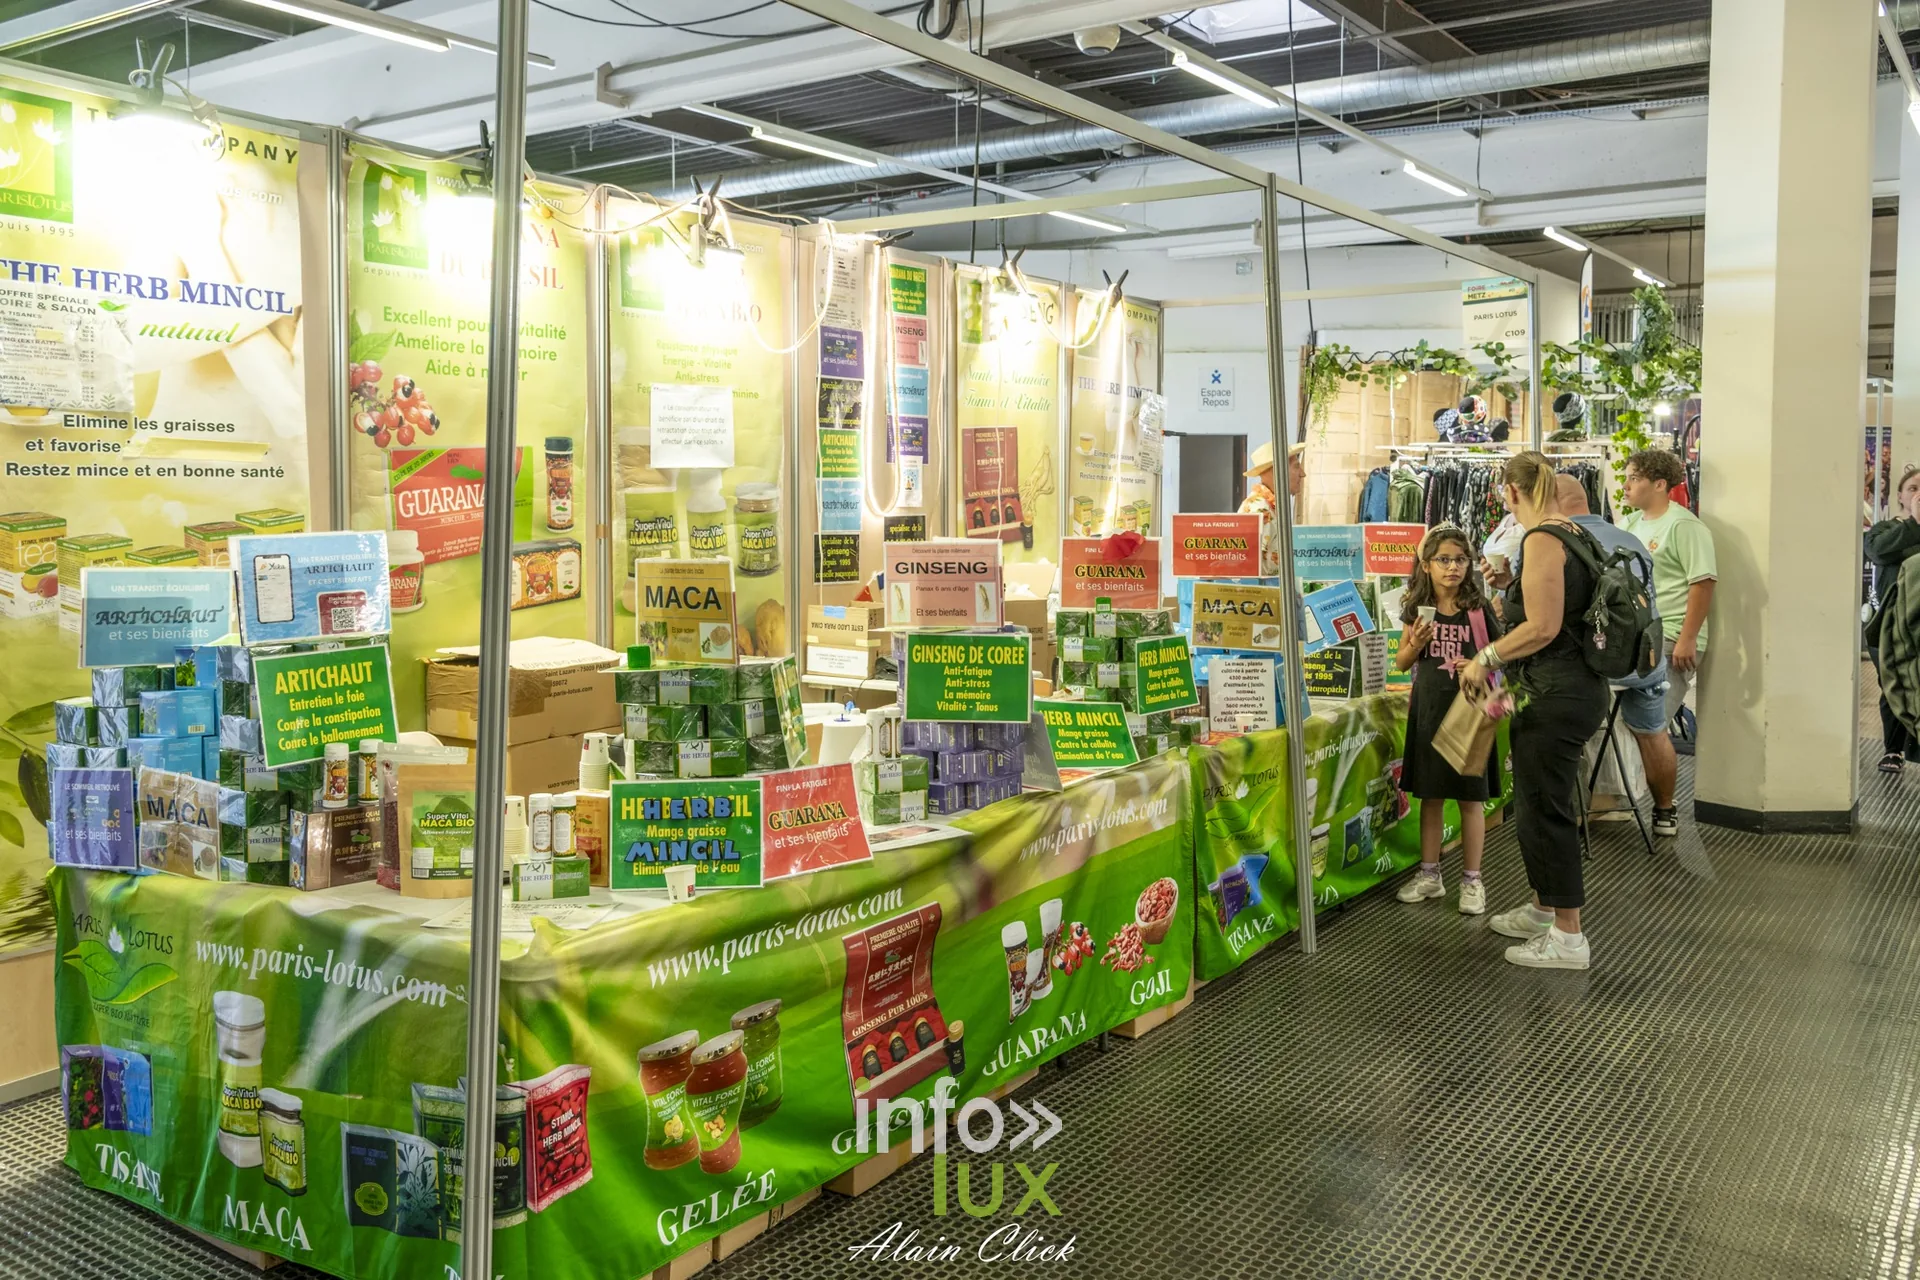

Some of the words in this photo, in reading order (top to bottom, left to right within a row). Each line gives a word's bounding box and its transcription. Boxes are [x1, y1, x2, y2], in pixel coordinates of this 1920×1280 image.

[72, 267, 169, 300] HERB
[179, 279, 294, 315] MINCIL
[383, 306, 452, 329] Excellent
[1505, 329, 1526, 337] C109
[395, 332, 465, 354] Améliore
[471, 339, 485, 355] la
[425, 359, 461, 377] Aide
[466, 361, 475, 377] à
[675, 370, 719, 383] Anti-stress
[1200, 388, 1231, 399] Espace
[1203, 397, 1229, 406] Repos
[63, 414, 128, 430] Elimine
[134, 416, 158, 431] les
[164, 419, 236, 433] graisses
[25, 438, 44, 452] et
[50, 438, 122, 453] favorise
[823, 434, 857, 446] ARTICHAUT
[6, 462, 70, 477] Restez
[76, 462, 129, 477] mince
[134, 464, 151, 477] et
[156, 465, 177, 478] en
[183, 464, 236, 478] bonne
[240, 465, 285, 478] santé
[634, 518, 655, 532] Super
[655, 516, 673, 530] Vital
[692, 526, 710, 538] Super
[710, 524, 724, 536] Vital
[744, 528, 761, 538] Super
[761, 526, 774, 538] Vital
[690, 537, 713, 549] MACA
[715, 535, 727, 548] BIO
[742, 538, 762, 550] MACA
[765, 536, 776, 549] BIO
[1183, 537, 1248, 549] GUARANA
[827, 549, 849, 557] ginseng
[1185, 552, 1193, 560] et
[1210, 552, 1246, 561] bienfaits
[1294, 547, 1360, 558] ARTICHAUT
[303, 563, 376, 575] ARTICHAUT
[895, 561, 988, 574] GINSENG
[1320, 559, 1352, 567] bienfaits
[1074, 565, 1147, 579] GUARANA
[952, 585, 969, 593] d'âge
[1075, 582, 1084, 590] et
[1085, 583, 1101, 591] ses
[1103, 581, 1144, 591] bienfaits
[645, 586, 722, 610] MACA
[916, 608, 923, 616] Et
[939, 608, 967, 617] bienfaits
[1202, 598, 1274, 617] MACA
[95, 606, 224, 626] ARTICHAUT
[109, 627, 125, 641] et
[127, 629, 149, 640] ses
[152, 626, 209, 641] bienfaits
[1432, 621, 1470, 642] TEEN
[912, 645, 965, 664] GINSENG
[969, 646, 984, 664] DE
[987, 646, 1025, 665] COREE
[1139, 650, 1158, 666] HERB
[1159, 646, 1187, 663] MINCIL
[1430, 641, 1465, 660] GIRL
[275, 661, 373, 695] ARTICHAUT
[943, 666, 993, 678] Anti-fatigue
[1148, 668, 1161, 678] Mange
[1163, 667, 1179, 677] graisse
[945, 678, 991, 688] Anti-stress
[1147, 681, 1159, 691] Contre
[1161, 680, 1166, 689] la
[1167, 678, 1184, 688] cellulite
[290, 697, 333, 712] Entretien
[335, 693, 344, 705] le
[347, 690, 365, 703] foie
[944, 690, 954, 699] La
[956, 689, 991, 699] mémoire
[936, 700, 967, 712] Vitalité
[975, 701, 999, 712] Tonus
[277, 717, 310, 732] Contre
[312, 713, 321, 727] la
[324, 707, 381, 724] constipation
[1042, 710, 1072, 725] HERB
[1076, 712, 1122, 726] MINCIL
[279, 737, 307, 751] Conre
[310, 733, 318, 745] le
[321, 723, 384, 744] ballonnement
[1058, 729, 1082, 738] Mange
[1083, 730, 1109, 738] graisse
[1056, 741, 1080, 749] Contre
[1090, 740, 1117, 749] cellulite
[1055, 752, 1093, 760] Elimination
[1095, 751, 1105, 760] de
[1106, 751, 1124, 760] l'eau
[776, 784, 790, 792] FINI
[802, 779, 827, 789] FATIGUE
[146, 793, 210, 829] MACA
[426, 812, 448, 820] Super
[643, 797, 732, 820] HERB
[768, 800, 848, 831] GUARANA
[420, 819, 453, 827] MACA
[456, 819, 475, 827] BIO
[65, 829, 75, 839] et
[75, 831, 87, 840] ses
[88, 828, 122, 842] bienfaits
[646, 825, 685, 839] Mange
[687, 826, 727, 839] graisse
[775, 838, 786, 849] et
[788, 834, 805, 846] ses
[806, 825, 849, 844] bienfaits
[625, 839, 740, 863] MINCIL
[647, 887, 904, 989] www.paris-lotus.com
[869, 927, 898, 944] PREMIERE
[896, 918, 920, 934] QUALITE
[196, 940, 447, 1008] www.paris-lotus.com
[1130, 968, 1174, 1005] GOJI
[852, 1013, 887, 1037] GINSENG
[888, 1003, 905, 1018] PUR
[905, 991, 929, 1009] 100%
[982, 1009, 1087, 1076] GUARANA
[755, 1053, 775, 1070] FORCE
[243, 1097, 262, 1110] BIO
[692, 1095, 713, 1108] VITAL
[715, 1086, 742, 1102] FORCE
[543, 1131, 562, 1148] HERB
[657, 1168, 778, 1246] GELÉE
[225, 1194, 314, 1251] MACA
